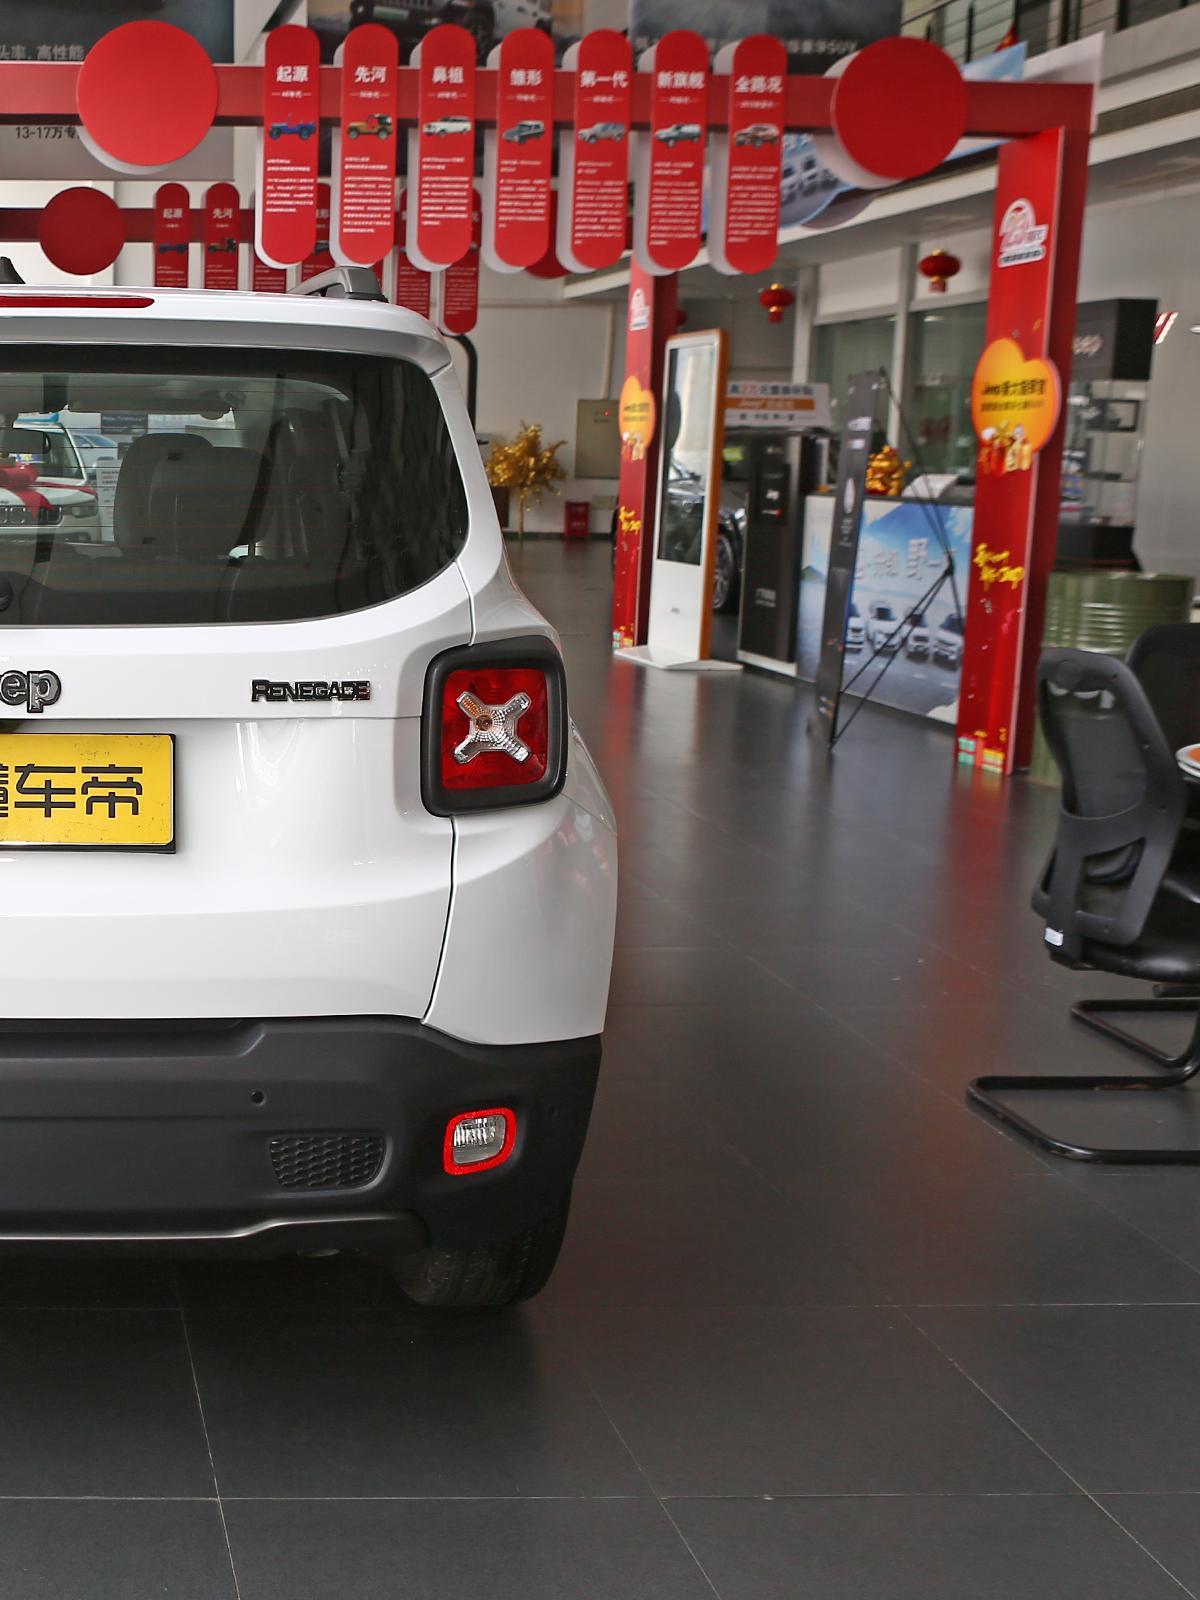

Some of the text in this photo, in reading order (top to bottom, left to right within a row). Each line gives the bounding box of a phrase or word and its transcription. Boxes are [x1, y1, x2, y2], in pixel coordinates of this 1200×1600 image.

[276, 65, 309, 83] 起源
[354, 66, 387, 83] 先河
[580, 70, 629, 88] 第一代
[251, 679, 371, 702] RENEGADE
